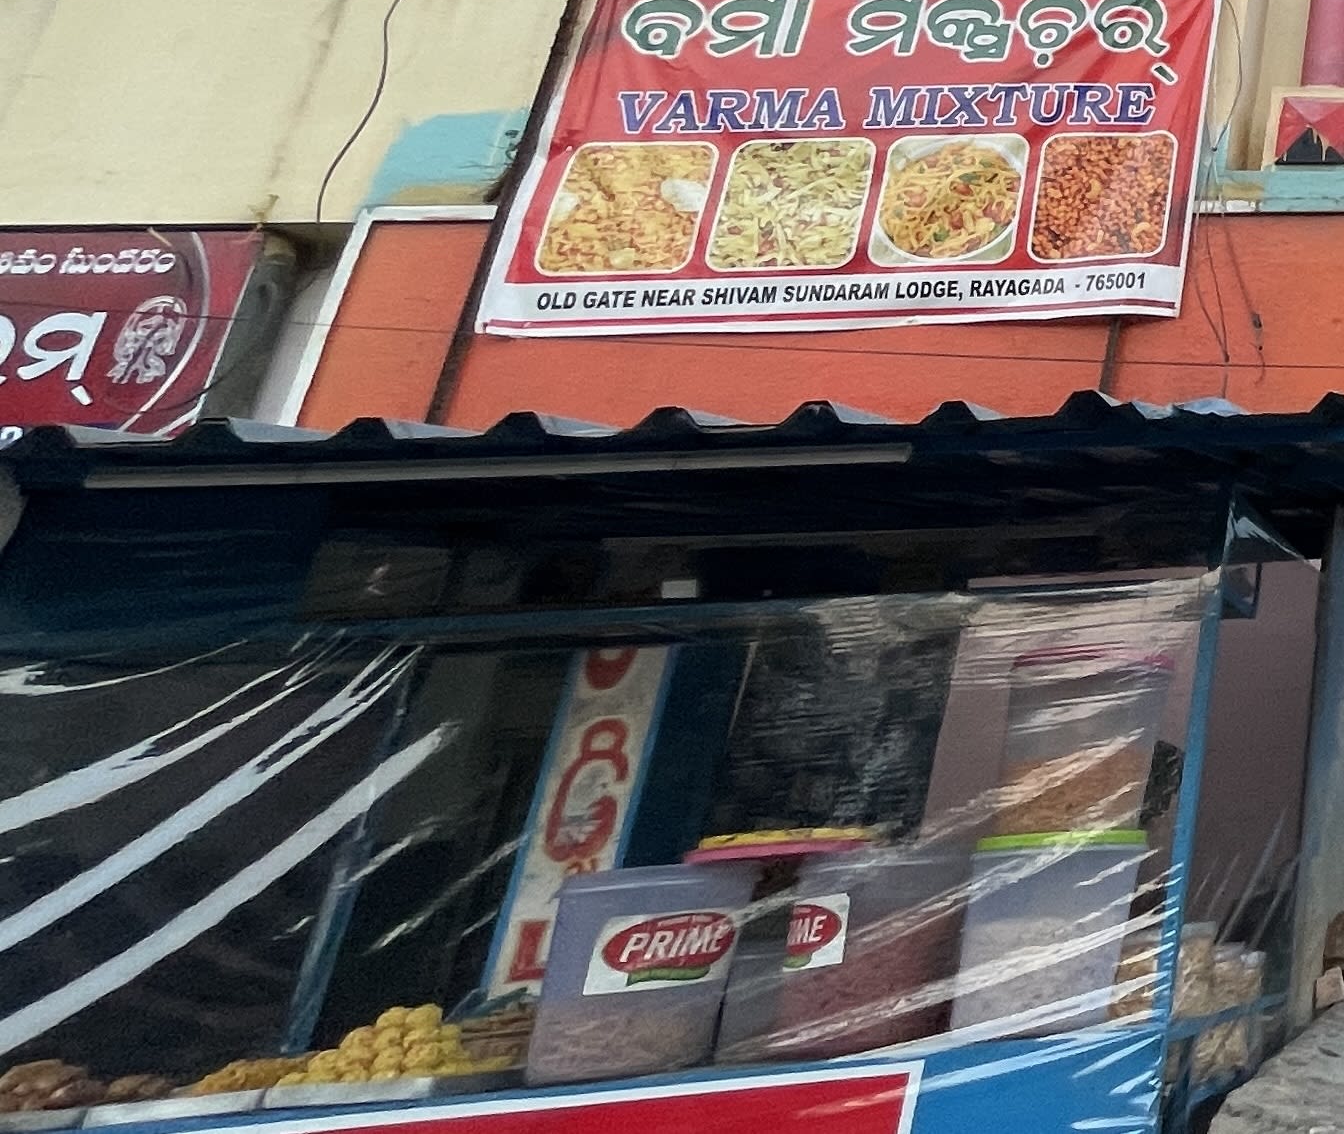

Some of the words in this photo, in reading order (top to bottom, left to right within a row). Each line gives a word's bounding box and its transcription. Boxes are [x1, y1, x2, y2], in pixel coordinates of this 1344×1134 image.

[618, 88, 844, 134] VARMA
[865, 83, 1155, 129] MIXTURE
[537, 291, 577, 310] OLD
[583, 290, 637, 309] GATE
[641, 289, 696, 308] NEAR
[701, 285, 777, 306] SHIVAM
[783, 282, 890, 303] SUNDARAM
[895, 280, 963, 301] LODGE,
[969, 277, 1065, 298] RAYAGADA
[1085, 272, 1146, 292] 765001
[618, 922, 732, 963] PRIME
